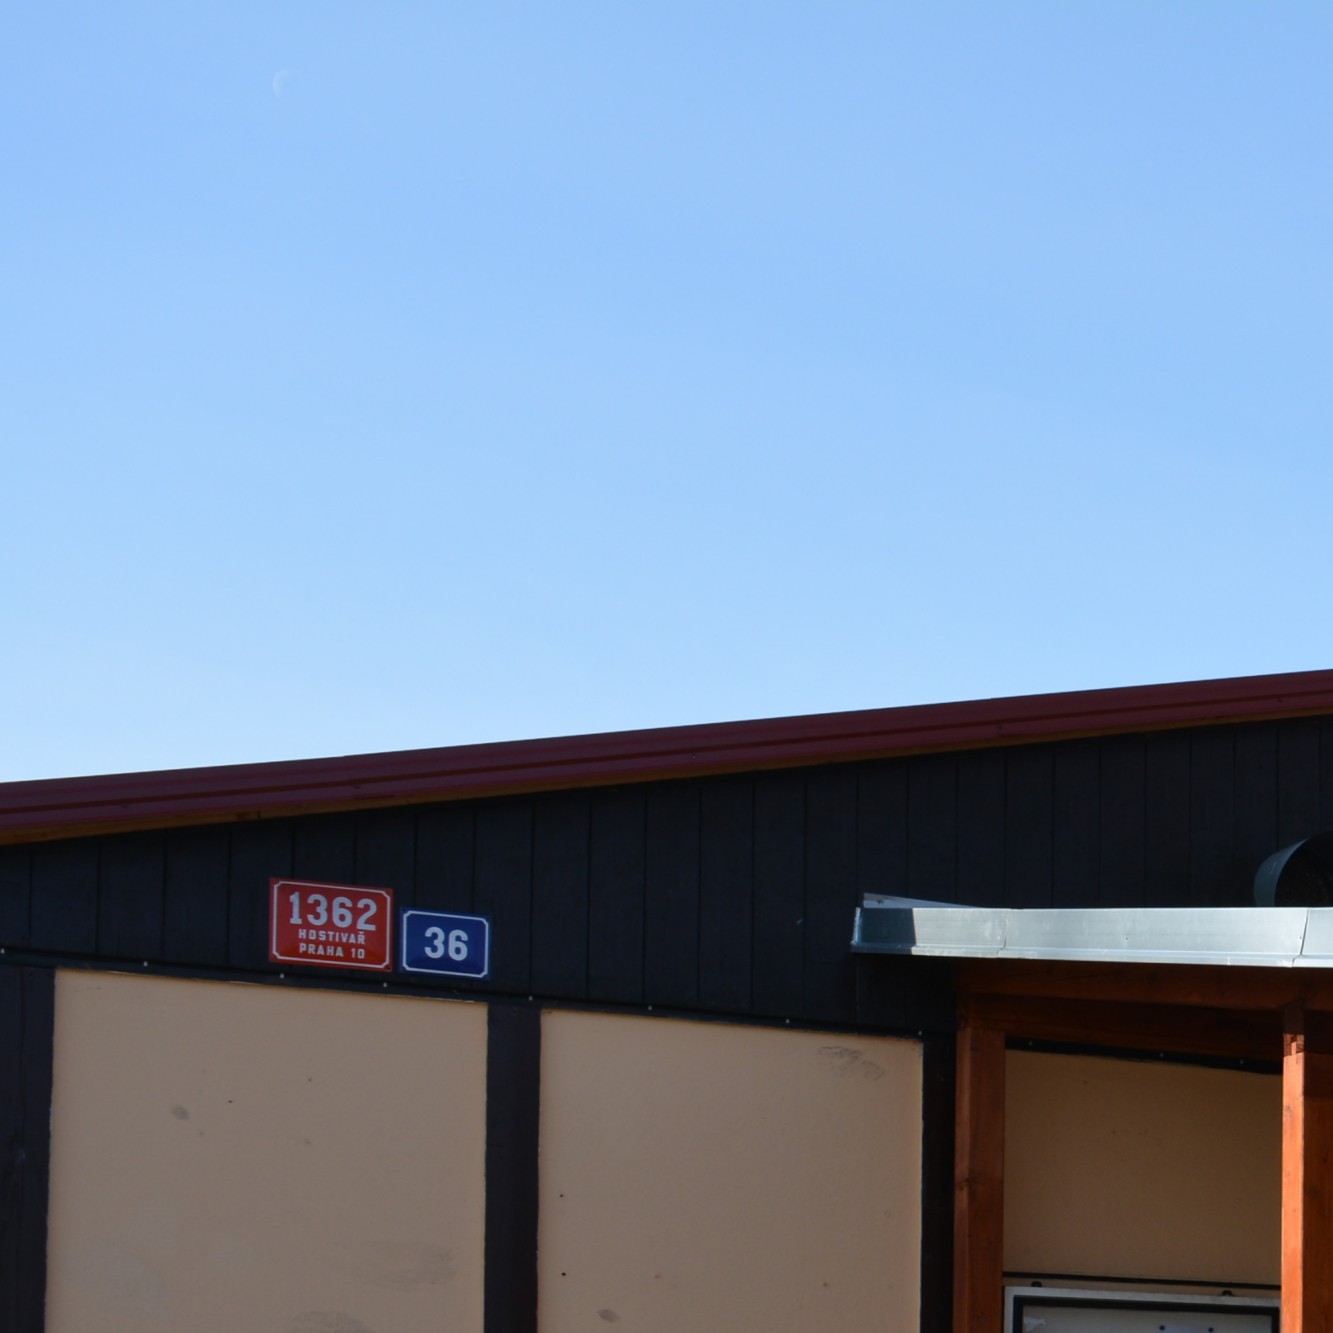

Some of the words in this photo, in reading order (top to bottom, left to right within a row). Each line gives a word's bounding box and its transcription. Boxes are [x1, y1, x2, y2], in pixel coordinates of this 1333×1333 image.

[289, 892, 377, 931] 1362
[298, 929, 365, 944] HOSTIVAŘ
[424, 926, 468, 961] 36
[299, 943, 344, 957] PRAHA
[351, 948, 365, 959] 10
